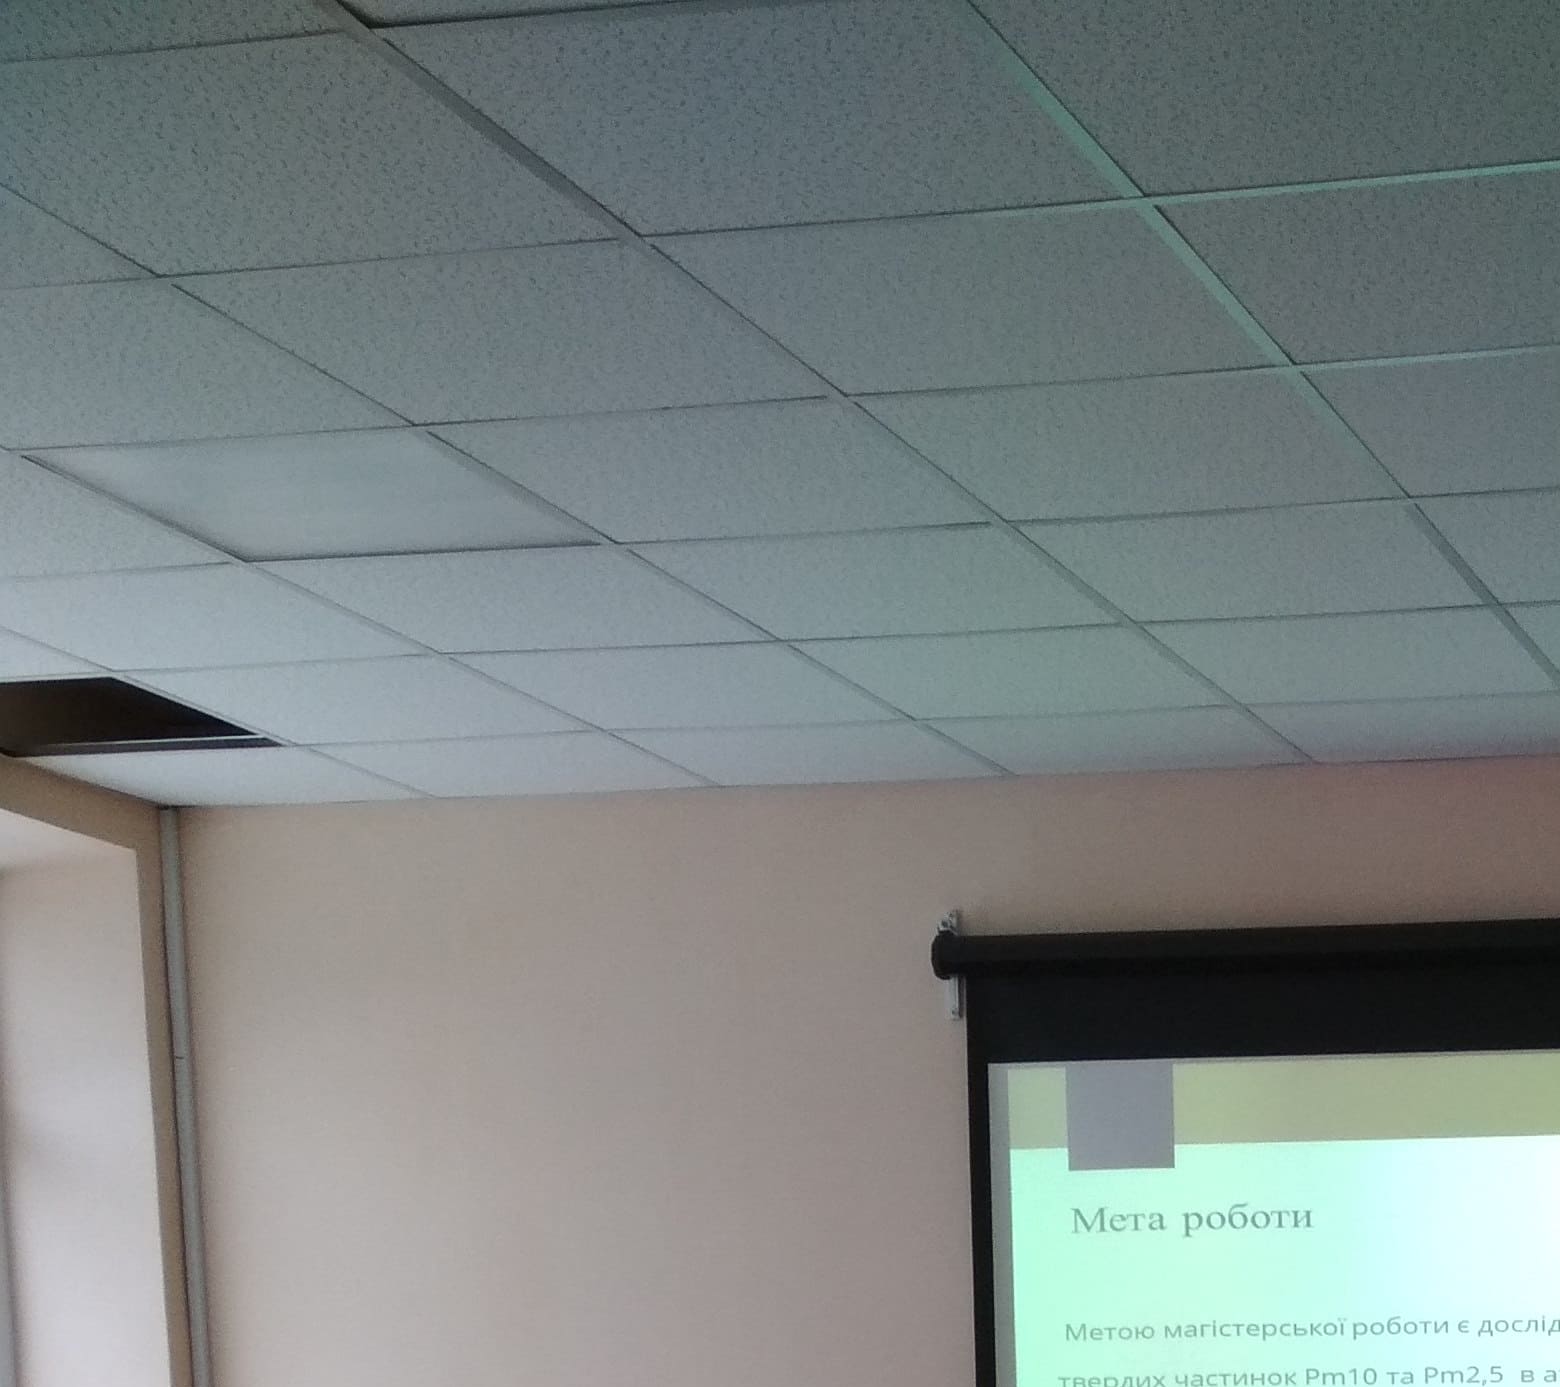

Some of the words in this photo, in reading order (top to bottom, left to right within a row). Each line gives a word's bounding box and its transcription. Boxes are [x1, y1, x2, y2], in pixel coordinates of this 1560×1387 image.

[1070, 1206, 1168, 1234] Мета
[1181, 1202, 1314, 1239] роботи
[1065, 1322, 1156, 1342] Метою
[1163, 1317, 1347, 1342] магістерської
[1352, 1315, 1449, 1341] роботи
[1457, 1319, 1470, 1334] є
[1305, 1367, 1378, 1387] Pm10
[1385, 1371, 1415, 1386] та
[1424, 1365, 1504, 1387] Pm2,5
[1520, 1369, 1535, 1384] в
